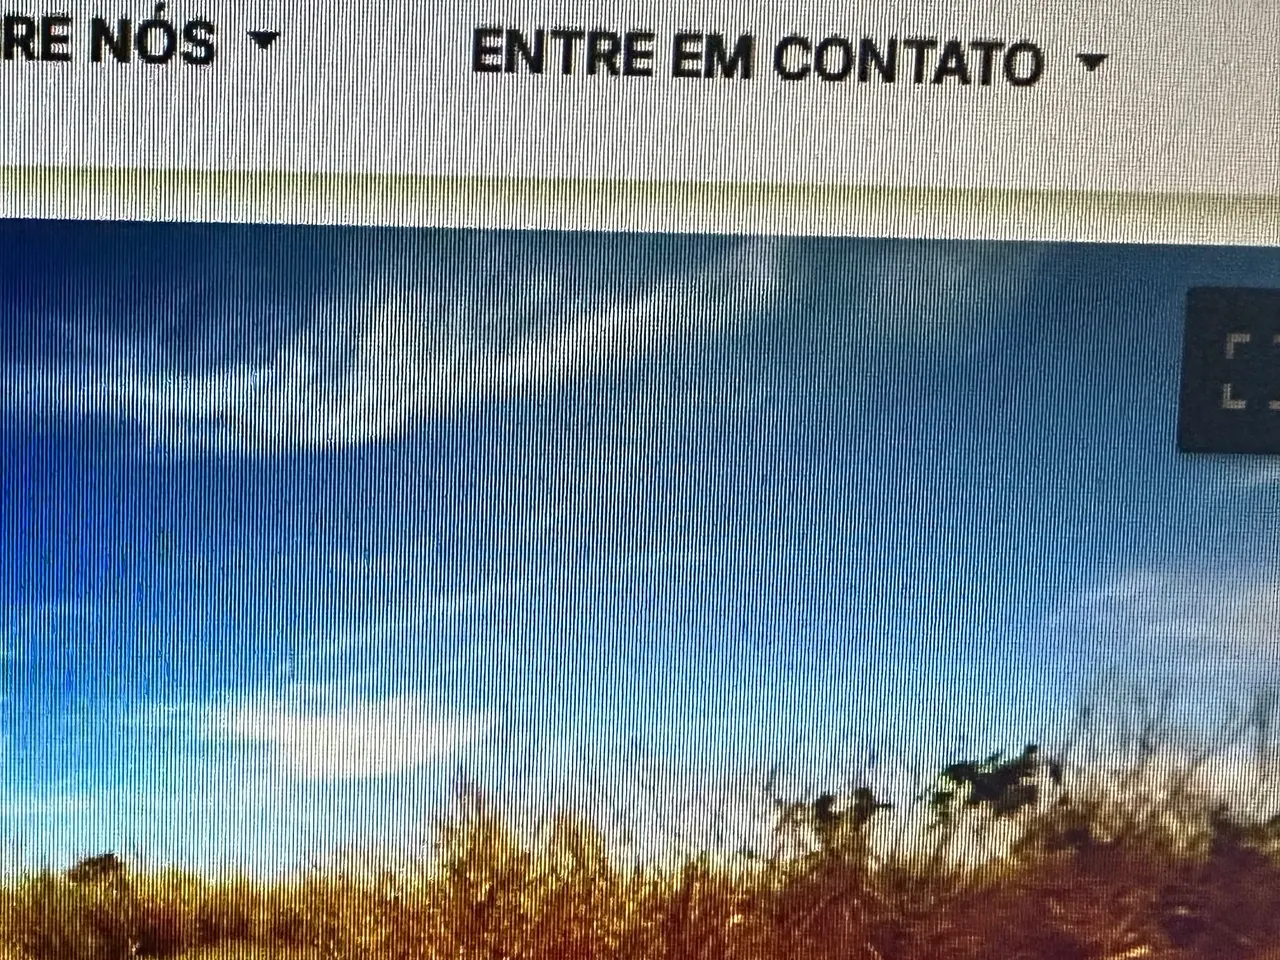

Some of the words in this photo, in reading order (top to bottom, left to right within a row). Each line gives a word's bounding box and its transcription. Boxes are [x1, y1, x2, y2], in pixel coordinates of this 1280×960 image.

[91, 2, 216, 66] NÓS
[472, 27, 655, 77] ENTRE
[672, 32, 756, 80] EM
[773, 34, 1044, 87] CONTATO
